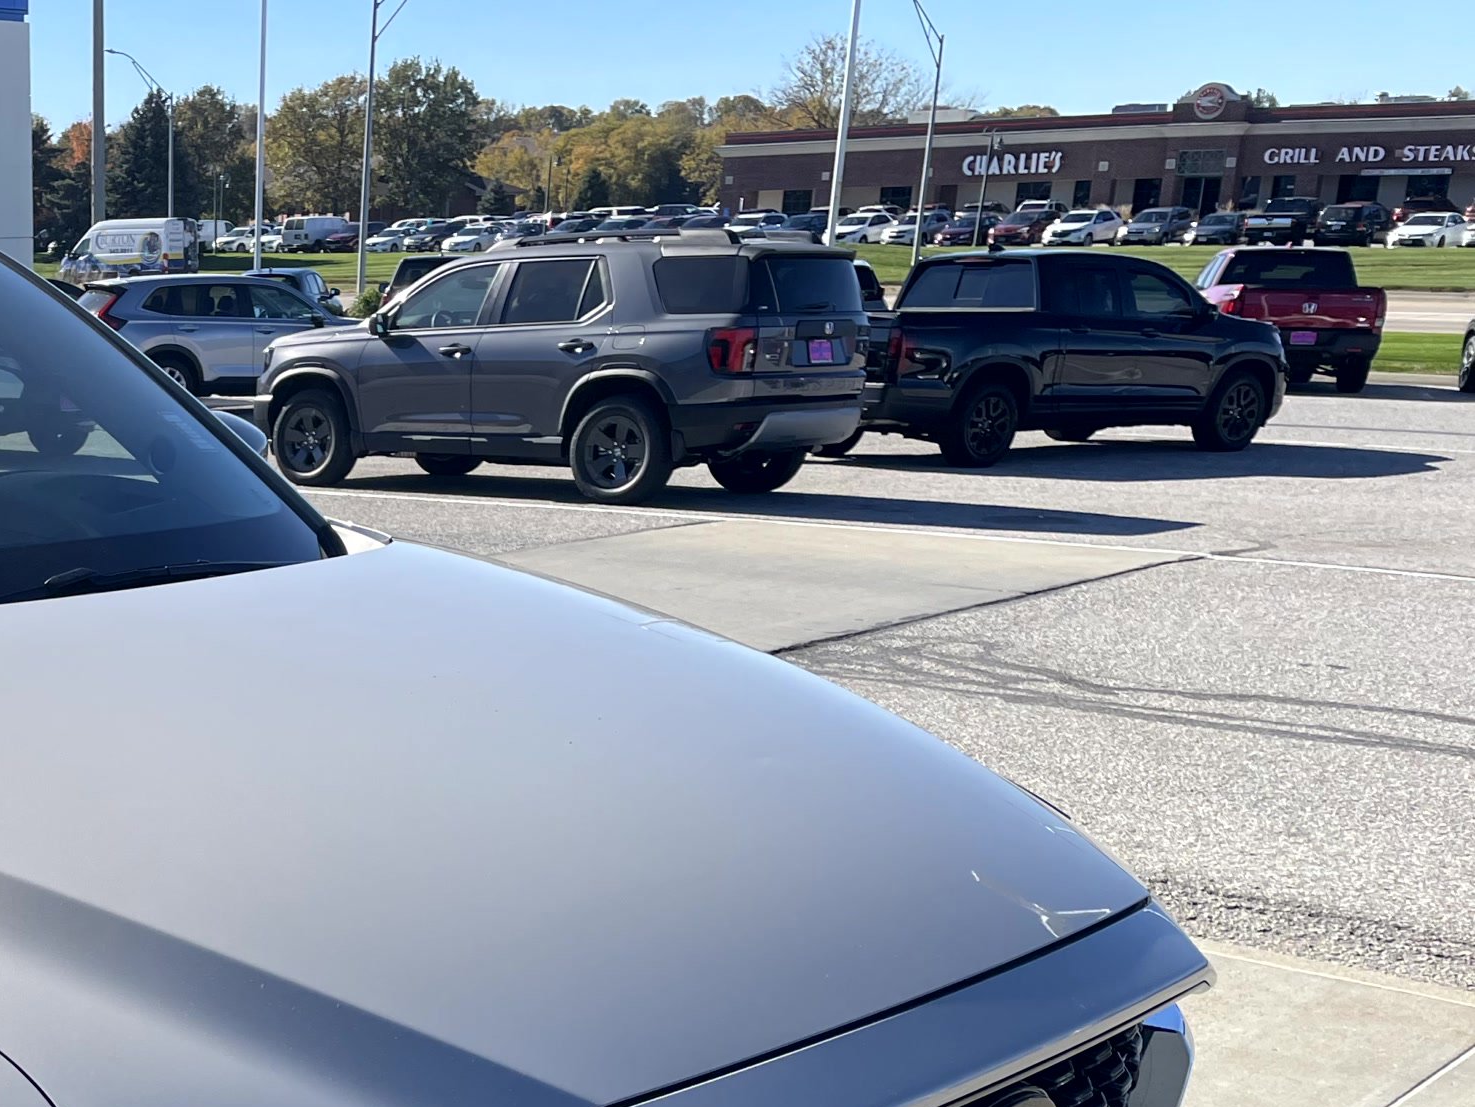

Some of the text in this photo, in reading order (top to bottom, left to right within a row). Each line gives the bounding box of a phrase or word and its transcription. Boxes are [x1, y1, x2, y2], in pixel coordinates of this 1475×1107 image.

[962, 150, 1063, 176] CHARLIE'S
[1263, 144, 1475, 164] GRILL AND STEAK
